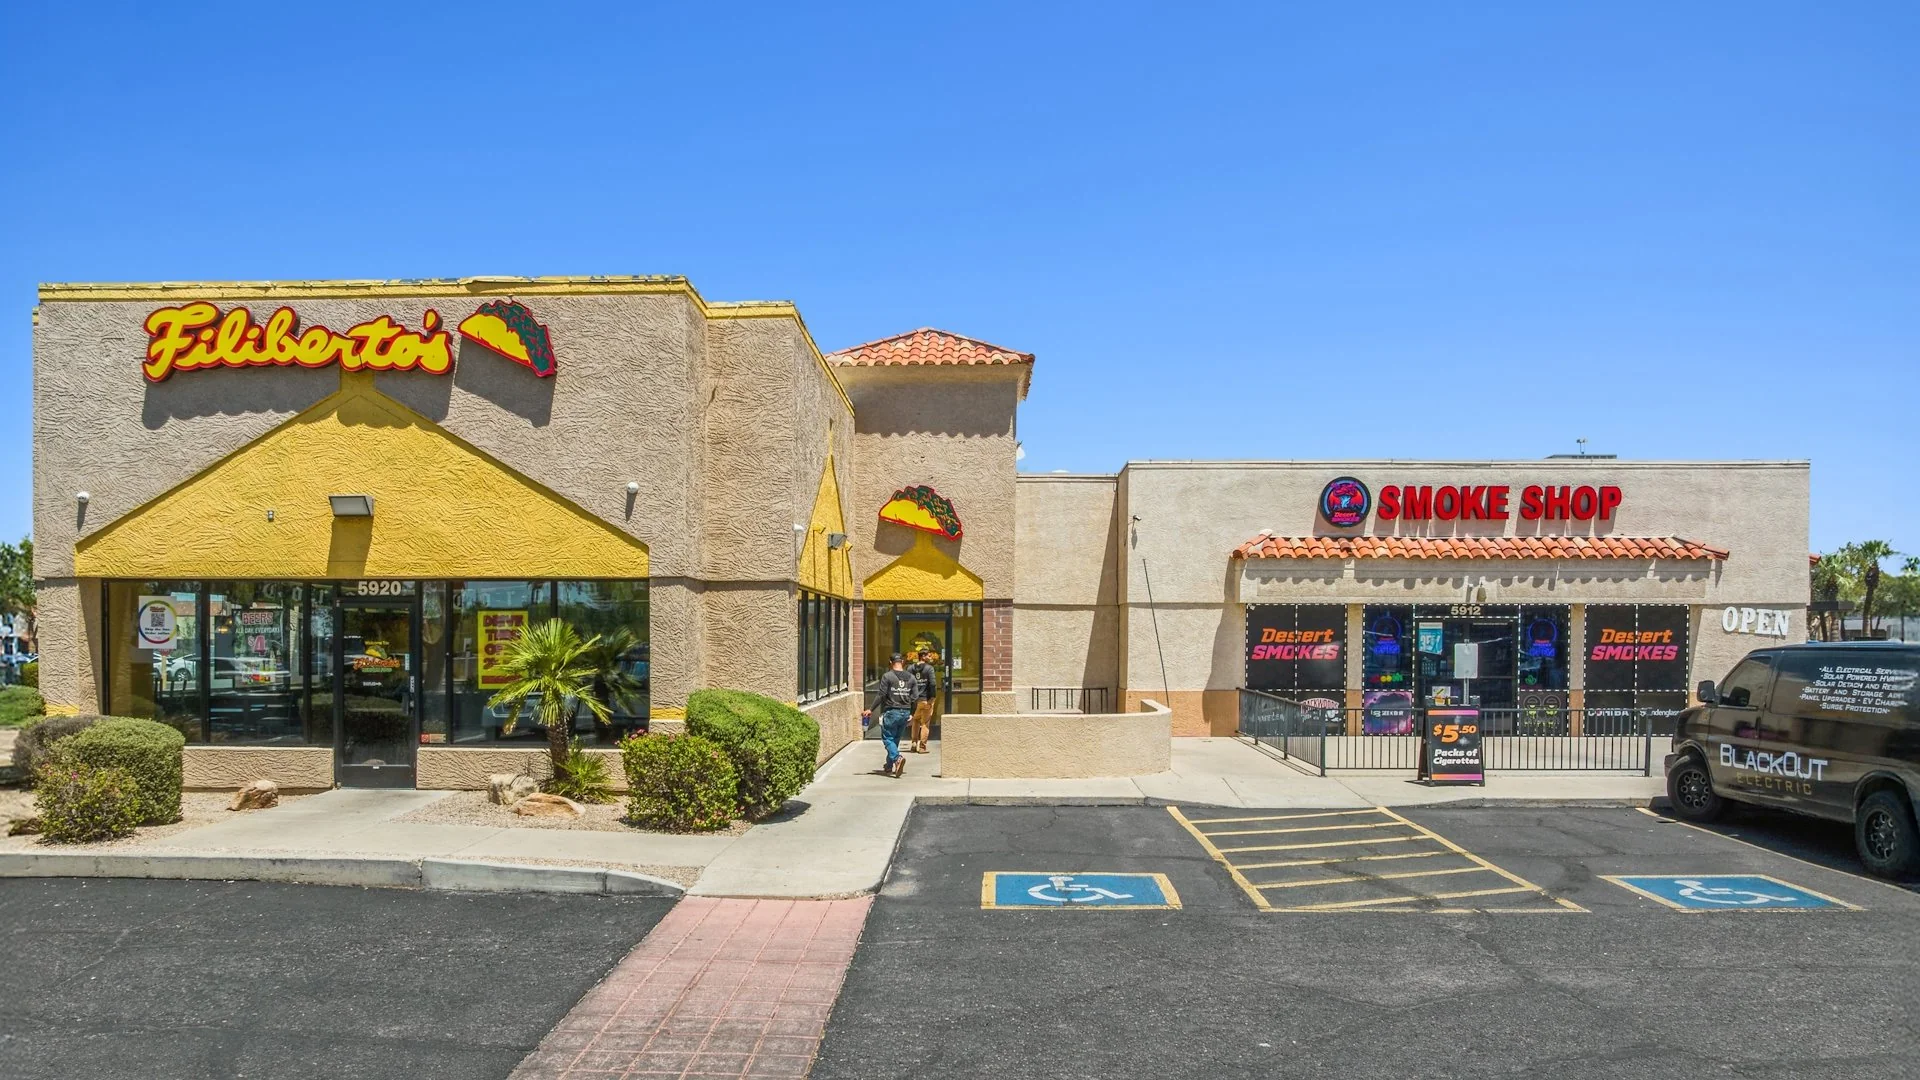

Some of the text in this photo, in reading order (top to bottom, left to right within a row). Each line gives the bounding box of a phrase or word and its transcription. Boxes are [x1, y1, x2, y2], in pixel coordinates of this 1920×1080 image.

[142, 301, 453, 382] Filiberto's
[1377, 485, 1622, 520] SMOKE SHOP
[358, 580, 402, 596] 5920
[1451, 606, 1481, 616] 5912
[243, 613, 273, 625] BEERS
[1722, 606, 1792, 637] OPEN
[1261, 628, 1335, 643] Desert
[1600, 628, 1673, 643] Desert
[1251, 645, 1340, 660] SMOKES
[1590, 645, 1679, 660] SMOKES
[1836, 666, 1873, 674] ELECTRICAL
[1804, 686, 1830, 694] BATTERY
[1852, 689, 1883, 697] STORAGE
[1838, 681, 1863, 689] DETACH
[1822, 695, 1856, 703] UPGRADES
[1845, 704, 1888, 714] PROTECTION
[1433, 723, 1477, 743] $5.50
[1434, 748, 1478, 757] Packs of
[1433, 757, 1480, 766] Cigarettes
[1736, 771, 1812, 795] ELECTRIC
